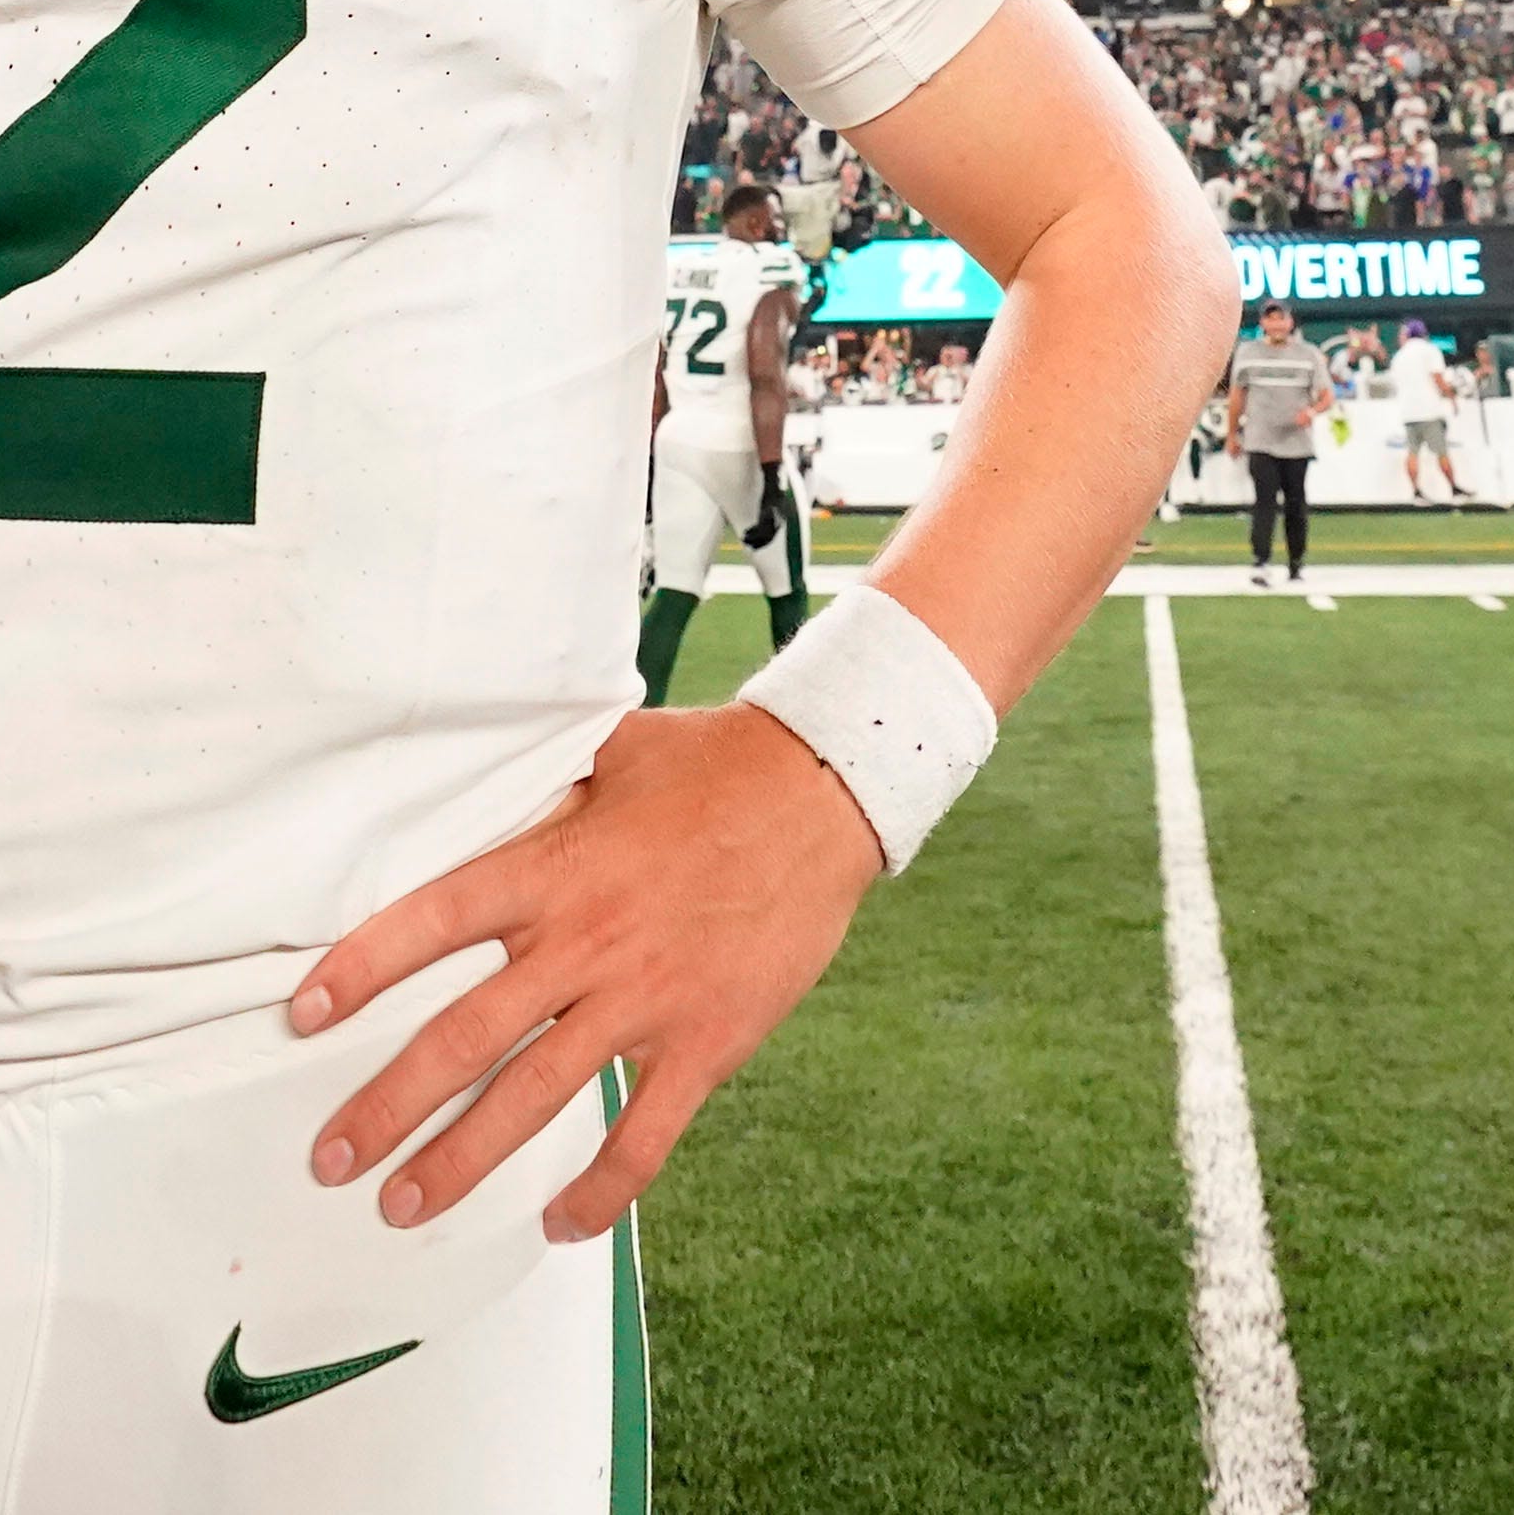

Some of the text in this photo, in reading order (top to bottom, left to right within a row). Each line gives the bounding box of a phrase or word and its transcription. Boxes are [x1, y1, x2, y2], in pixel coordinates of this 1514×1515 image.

[899, 242, 966, 309] 22
[1233, 239, 1485, 301] OVERTIME
[666, 298, 727, 375] 72
